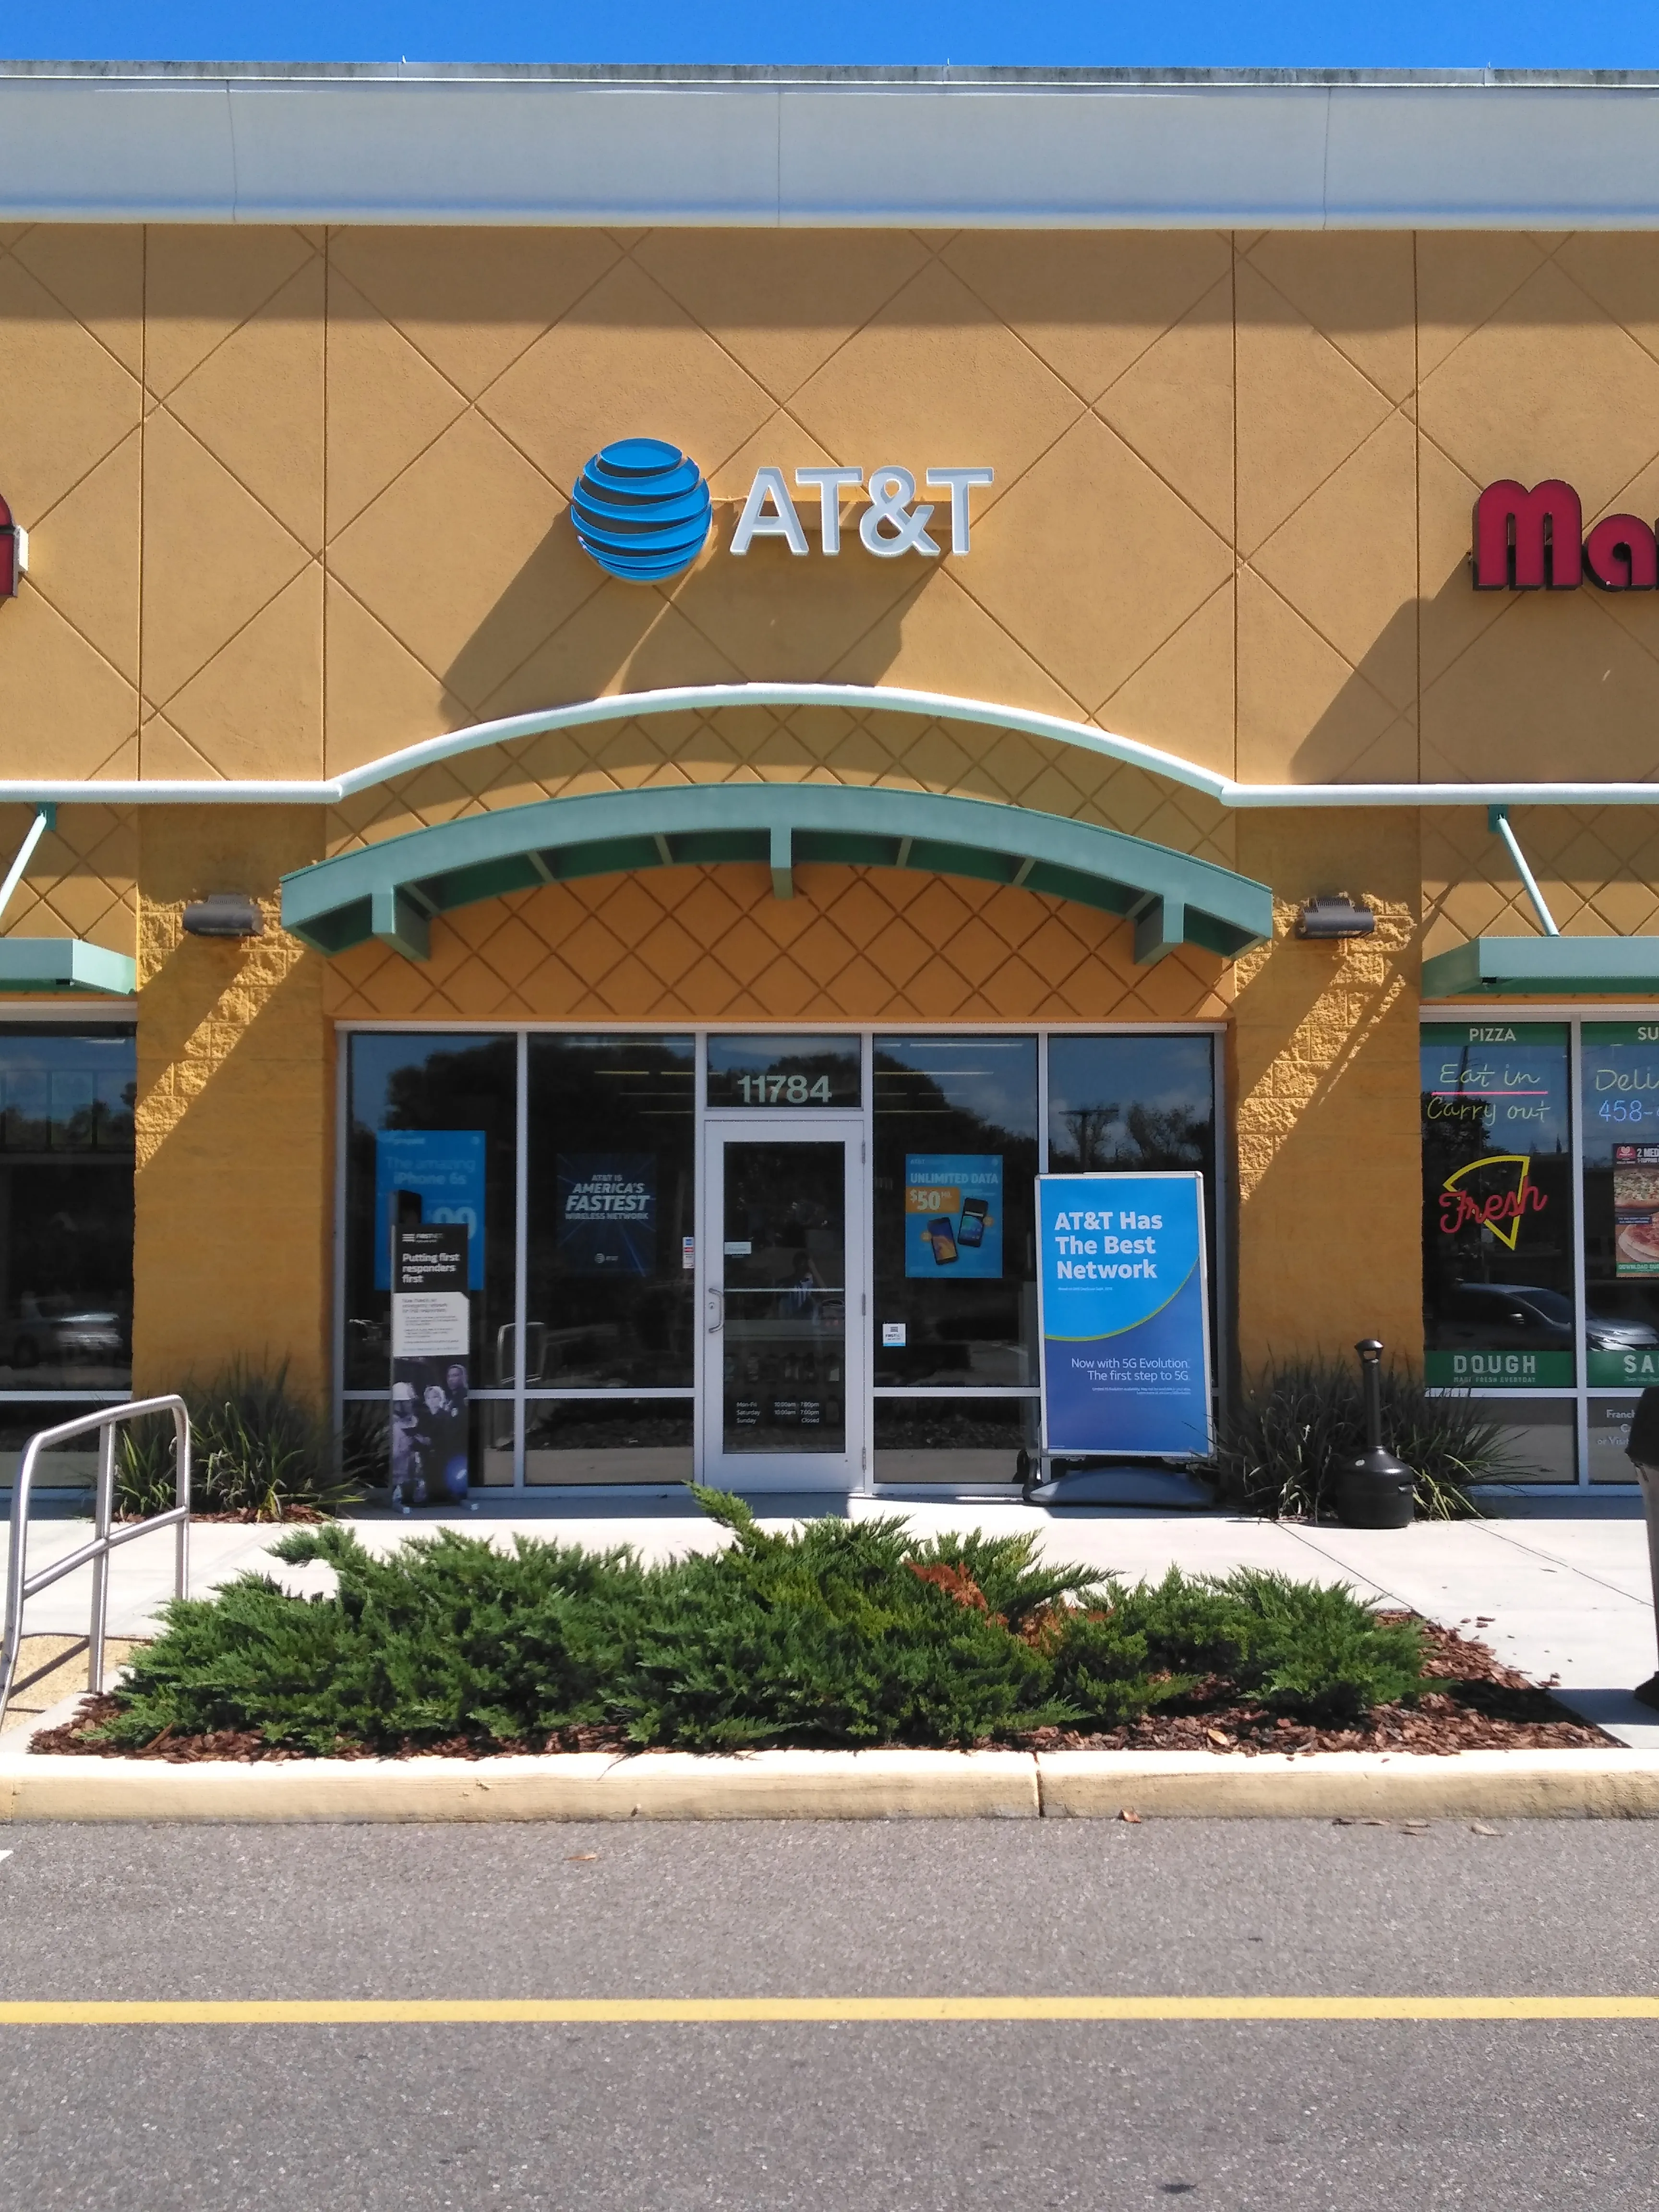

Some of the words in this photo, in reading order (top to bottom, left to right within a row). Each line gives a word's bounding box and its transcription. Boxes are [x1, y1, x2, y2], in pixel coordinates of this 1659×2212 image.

[730, 465, 994, 558] AT&T
[1472, 479, 1659, 592] Ma
[1469, 1028, 1516, 1041] PIZZA
[1440, 1064, 1495, 1087] Eat
[1504, 1064, 1540, 1086] in
[737, 1075, 832, 1103] 11784
[1427, 1096, 1496, 1126] Carry
[1507, 1100, 1551, 1123] out
[1599, 1099, 1659, 1122] 458-
[1636, 1148, 1643, 1157] 2
[572, 1183, 645, 1193] AMERICA'S
[910, 1173, 969, 1184] UNLIMITED
[971, 1173, 998, 1184] DATA
[565, 1195, 650, 1211] FASTEST
[910, 1189, 941, 1211] $50
[1439, 1176, 1548, 1233] Fresh
[1054, 1211, 1114, 1230] AT&T
[1119, 1211, 1163, 1230] Has
[1055, 1235, 1098, 1255] The
[1104, 1236, 1156, 1254] Best
[402, 1253, 438, 1263] Putting
[439, 1252, 461, 1262] first
[402, 1263, 457, 1274] responders
[1057, 1258, 1158, 1279] Network
[402, 1274, 424, 1283] first
[1071, 1358, 1095, 1369] Now
[1097, 1357, 1120, 1369] with
[1122, 1358, 1137, 1369] 5G
[1454, 1355, 1536, 1374] DOUGH
[1623, 1354, 1659, 1373] SA
[1087, 1370, 1107, 1381] The
[1109, 1370, 1132, 1381] first
[1134, 1370, 1158, 1383] step
[1160, 1370, 1172, 1381] to
